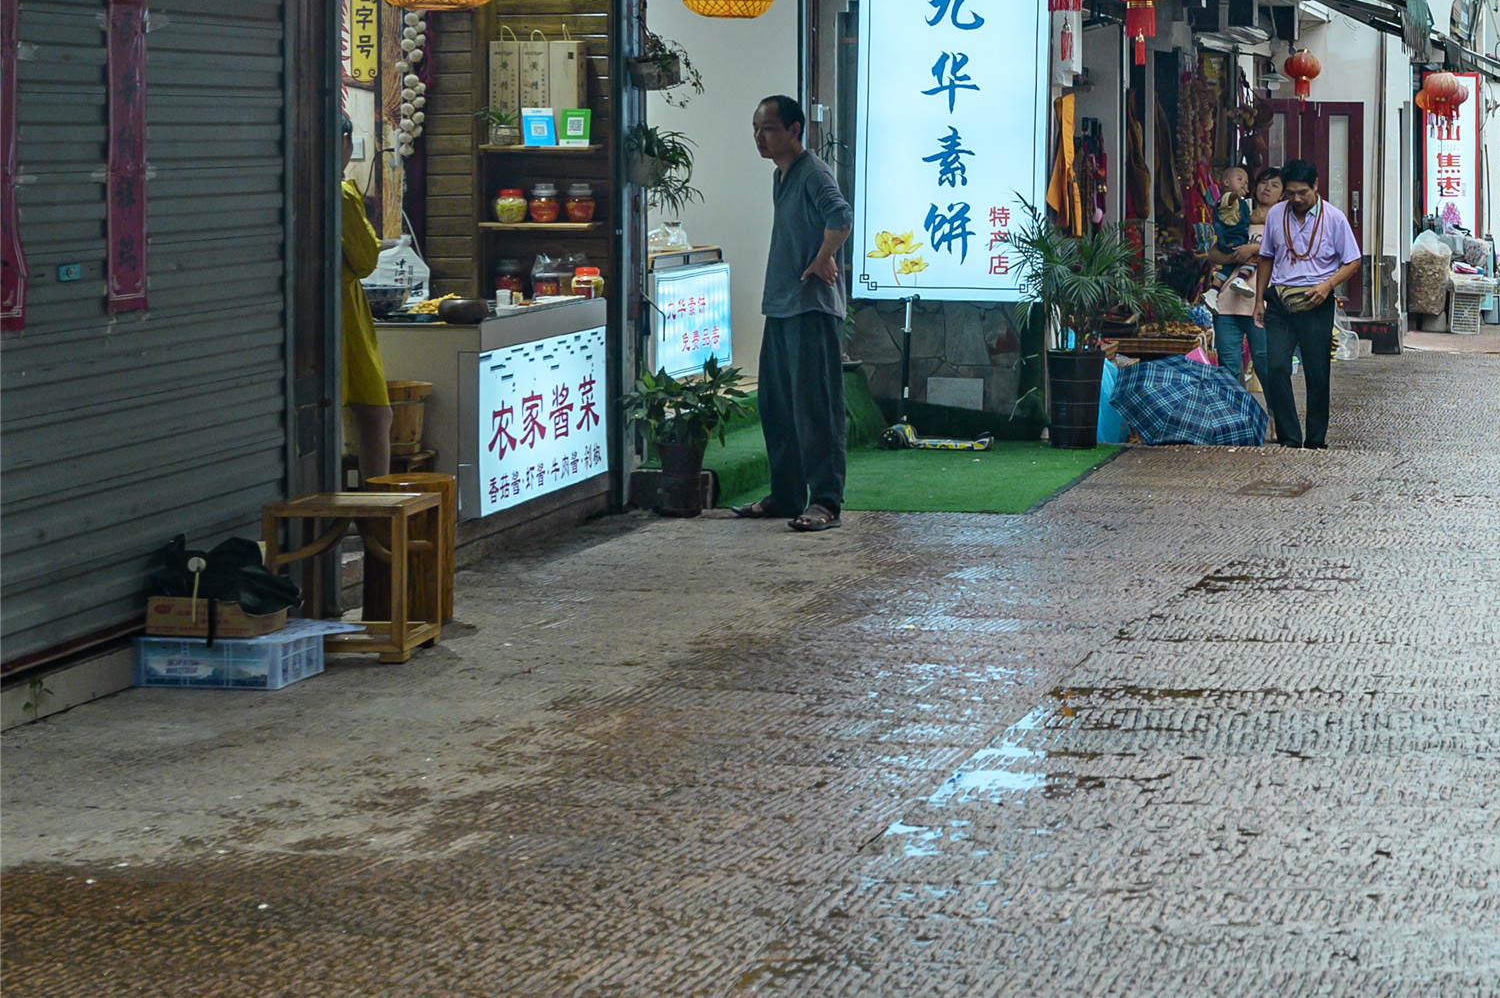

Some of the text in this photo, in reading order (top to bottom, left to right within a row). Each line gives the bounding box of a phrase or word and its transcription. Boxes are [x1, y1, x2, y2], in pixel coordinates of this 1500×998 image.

[988, 206, 1012, 276] 特产店
[682, 325, 720, 353] 免费品尝
[488, 373, 600, 461] 农家酱菜
